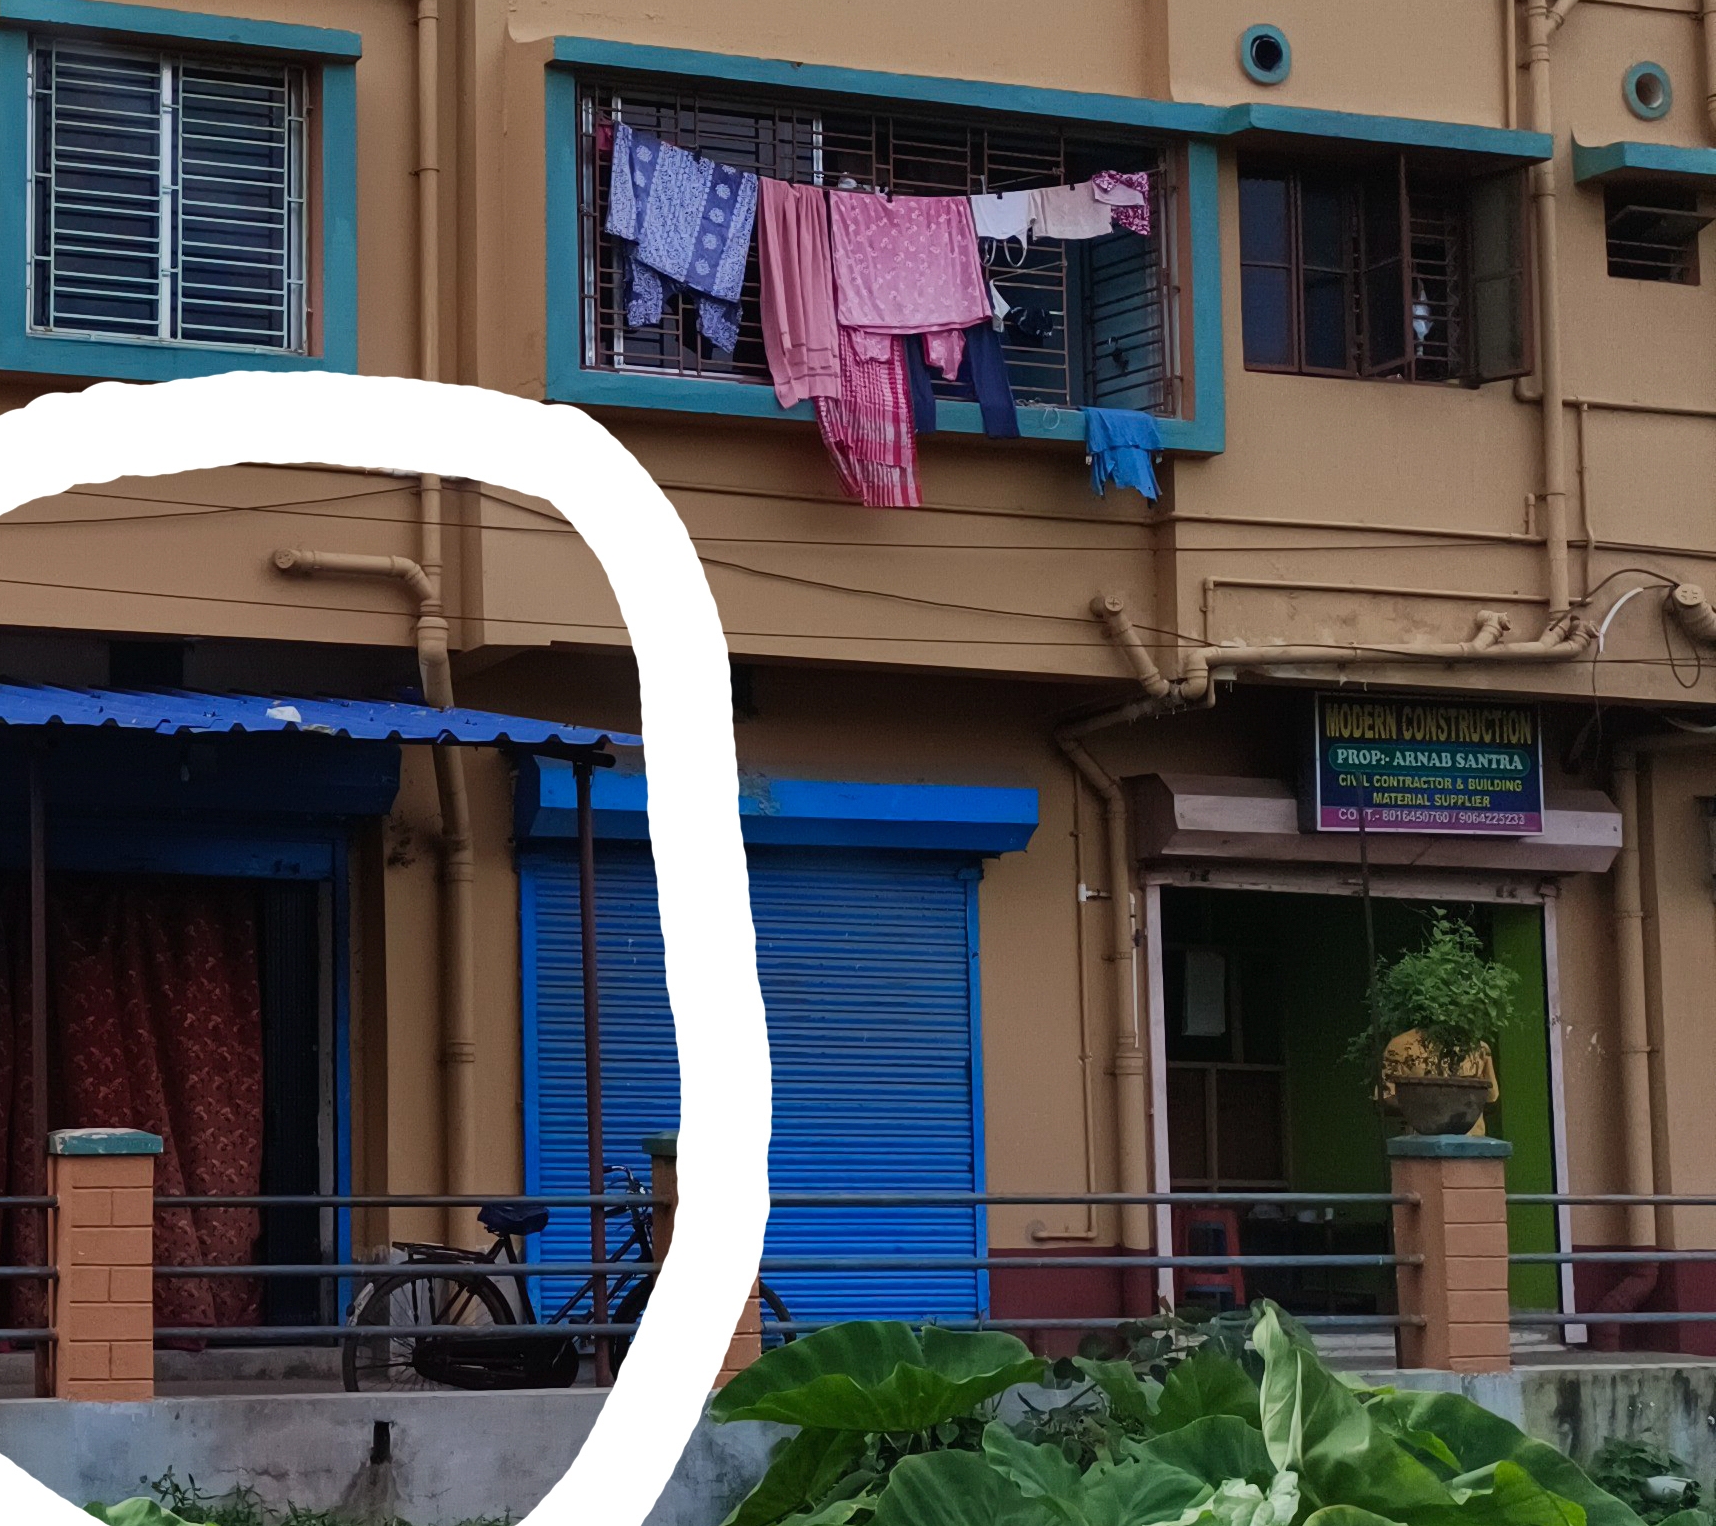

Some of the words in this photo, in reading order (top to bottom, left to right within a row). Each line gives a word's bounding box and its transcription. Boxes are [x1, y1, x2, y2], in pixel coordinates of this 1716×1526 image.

[1325, 703, 1397, 740] MODERN
[1392, 750, 1452, 767] ARNAB
[1455, 753, 1524, 770] SANTRA
[1373, 775, 1453, 789] CONTRACTOR
[1455, 778, 1464, 790] &
[1468, 778, 1523, 792] BUILDING
[1372, 792, 1431, 806] MATERIAL
[1433, 794, 1491, 808] SUPPLIER
